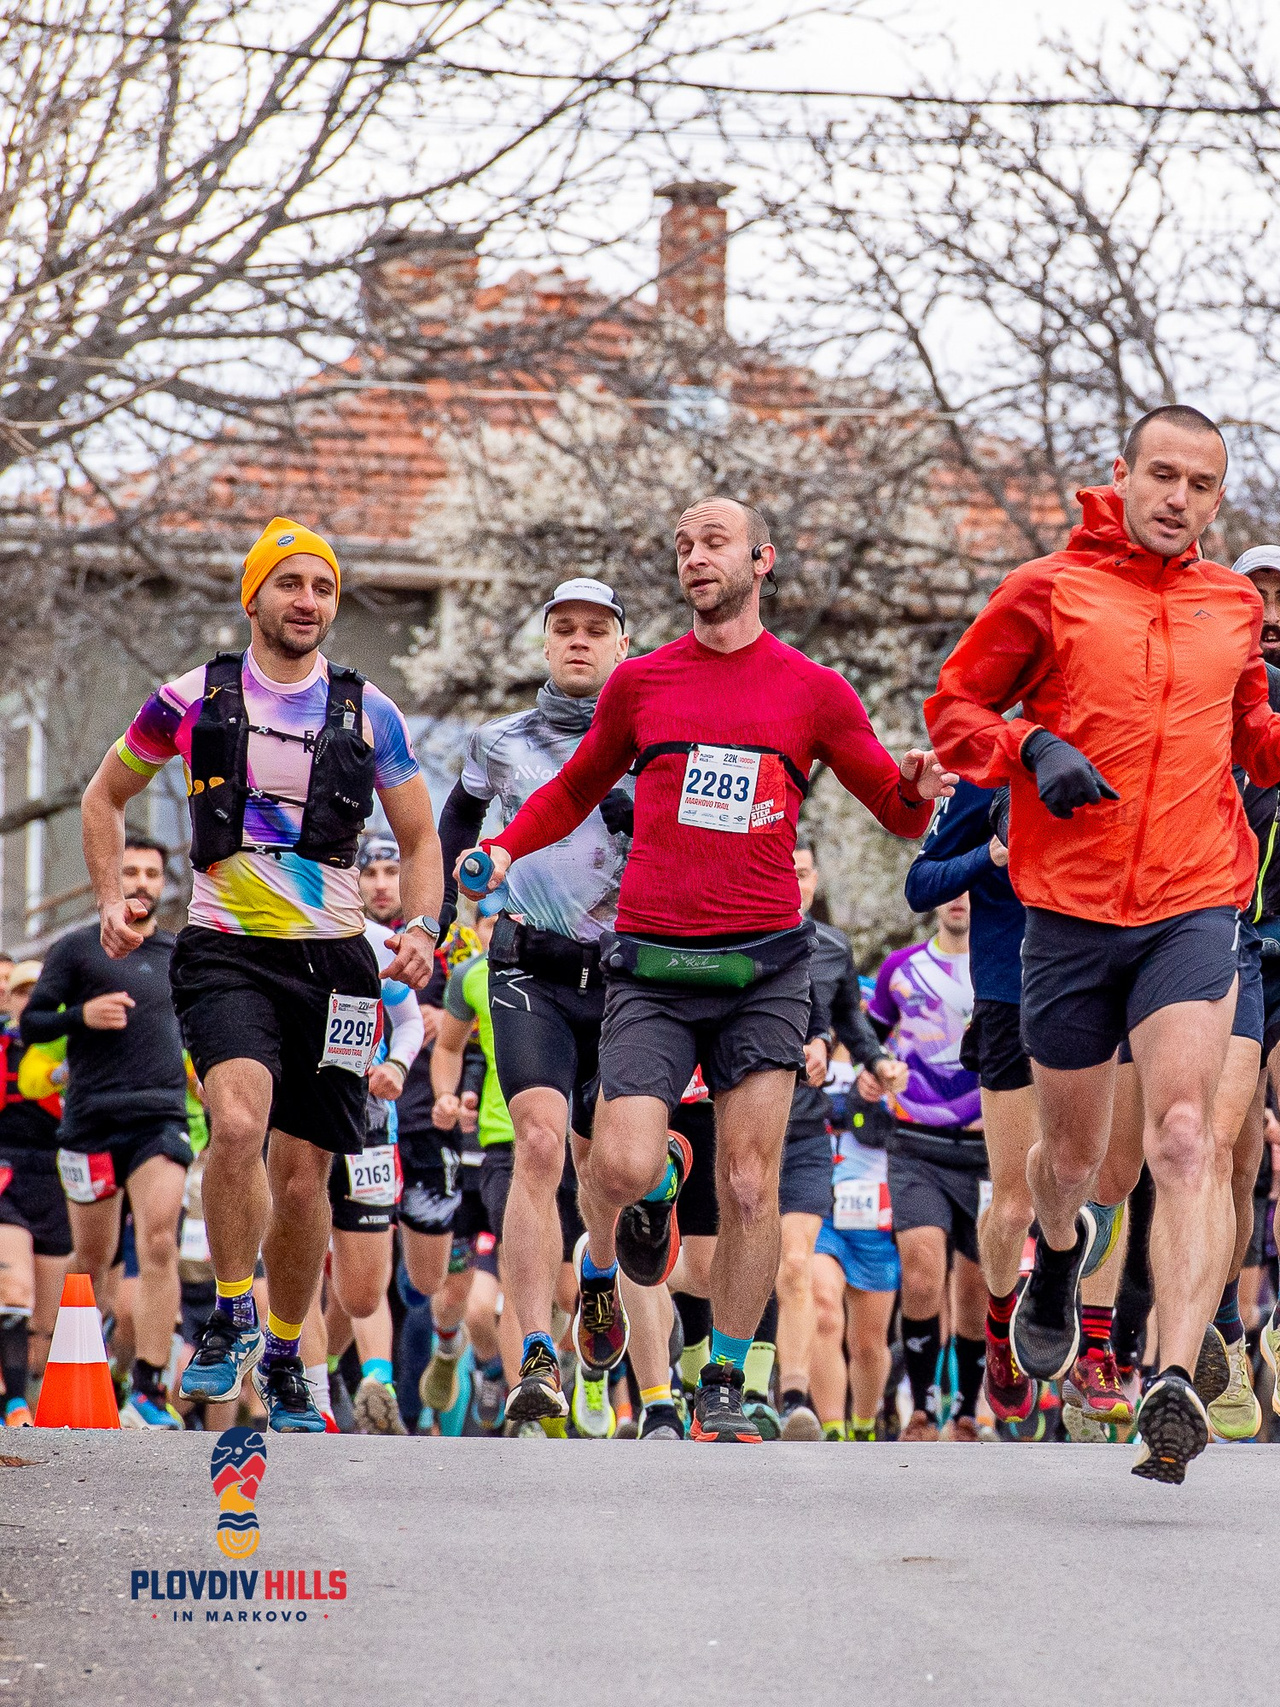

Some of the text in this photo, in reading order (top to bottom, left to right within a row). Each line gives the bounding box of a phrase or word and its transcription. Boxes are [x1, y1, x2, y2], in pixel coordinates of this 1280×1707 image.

[723, 753, 739, 764] 22K
[686, 768, 750, 803] 2283
[685, 796, 730, 811] MARKOVO TRAIL
[751, 799, 774, 812] EVERY
[750, 808, 771, 820] STEP
[329, 1018, 374, 1047] 2295
[328, 1047, 352, 1056] MARKOVO
[355, 1163, 391, 1187] 2163
